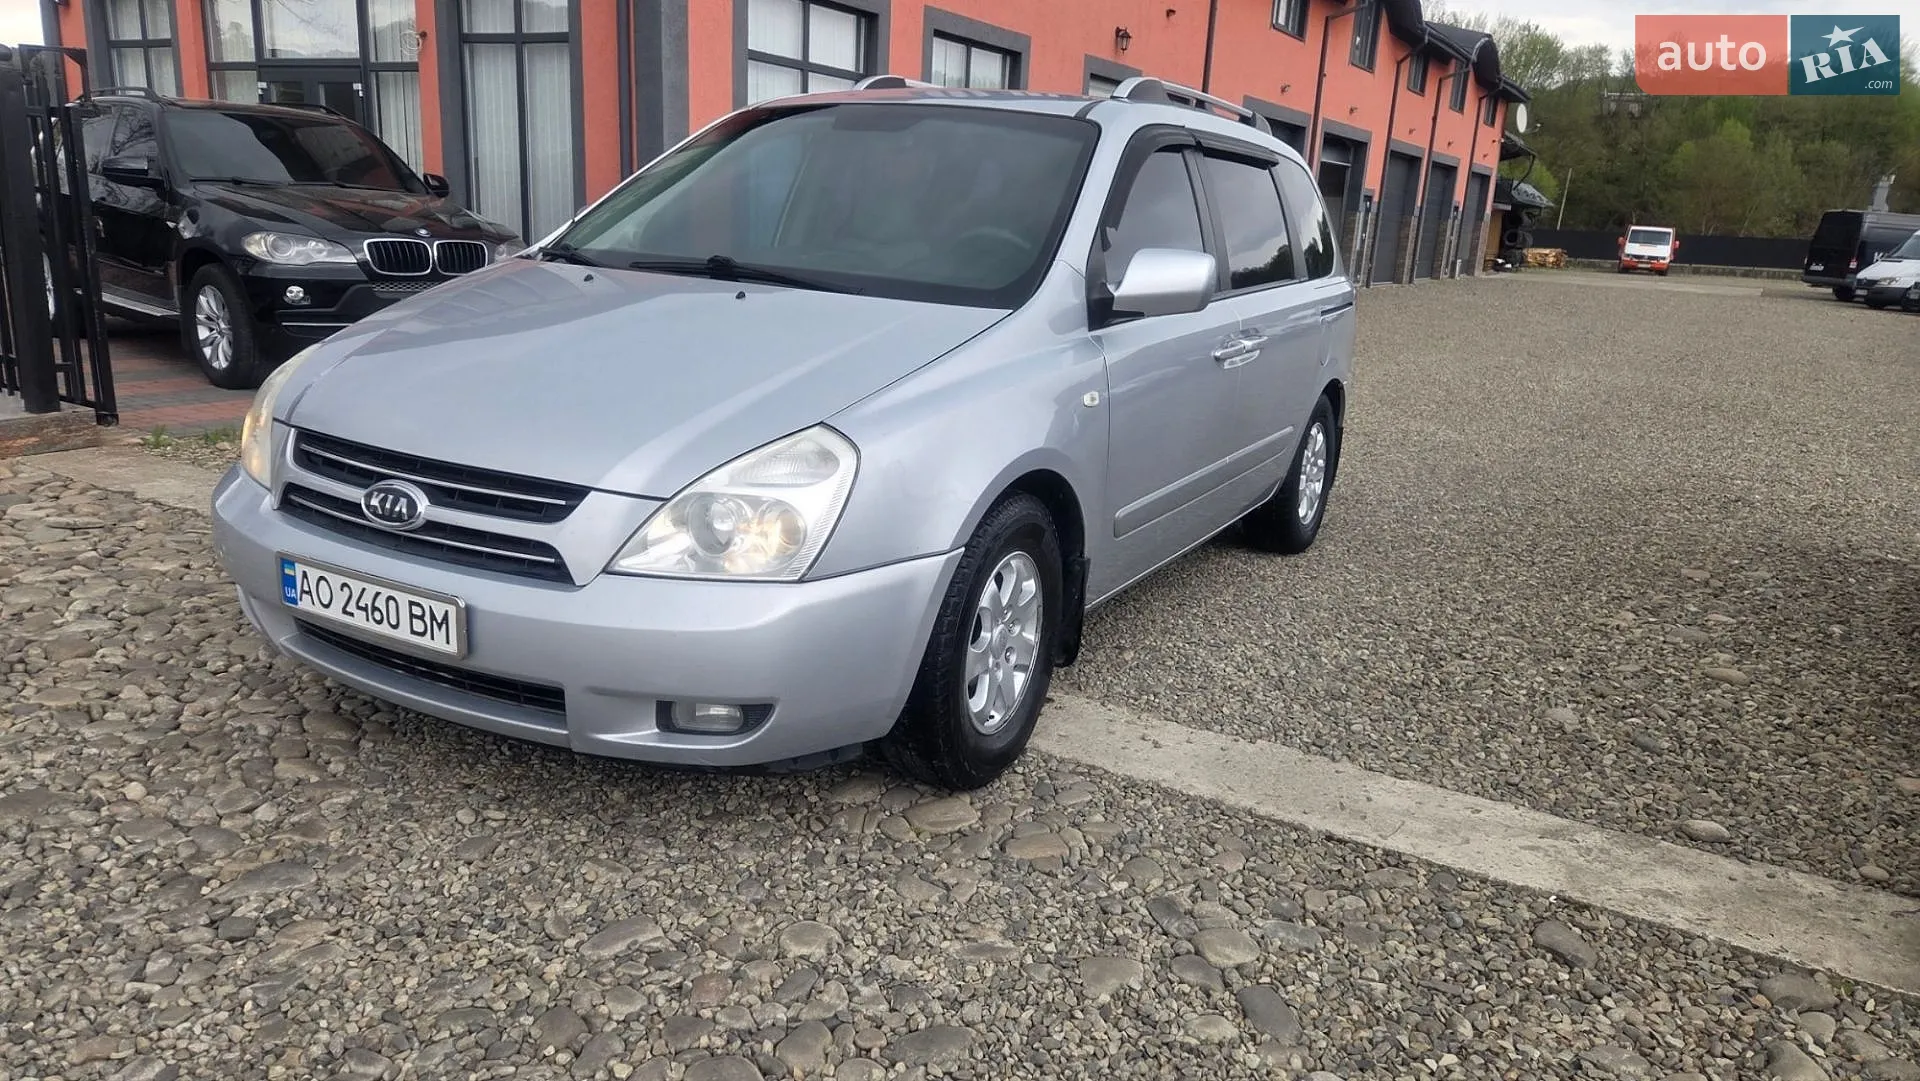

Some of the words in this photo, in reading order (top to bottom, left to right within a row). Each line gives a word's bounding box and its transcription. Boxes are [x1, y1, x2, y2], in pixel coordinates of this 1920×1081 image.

[369, 491, 409, 520] KIA
[284, 586, 297, 599] UA
[299, 570, 333, 609] AO
[340, 582, 401, 630] 2460
[408, 600, 450, 645] BM
